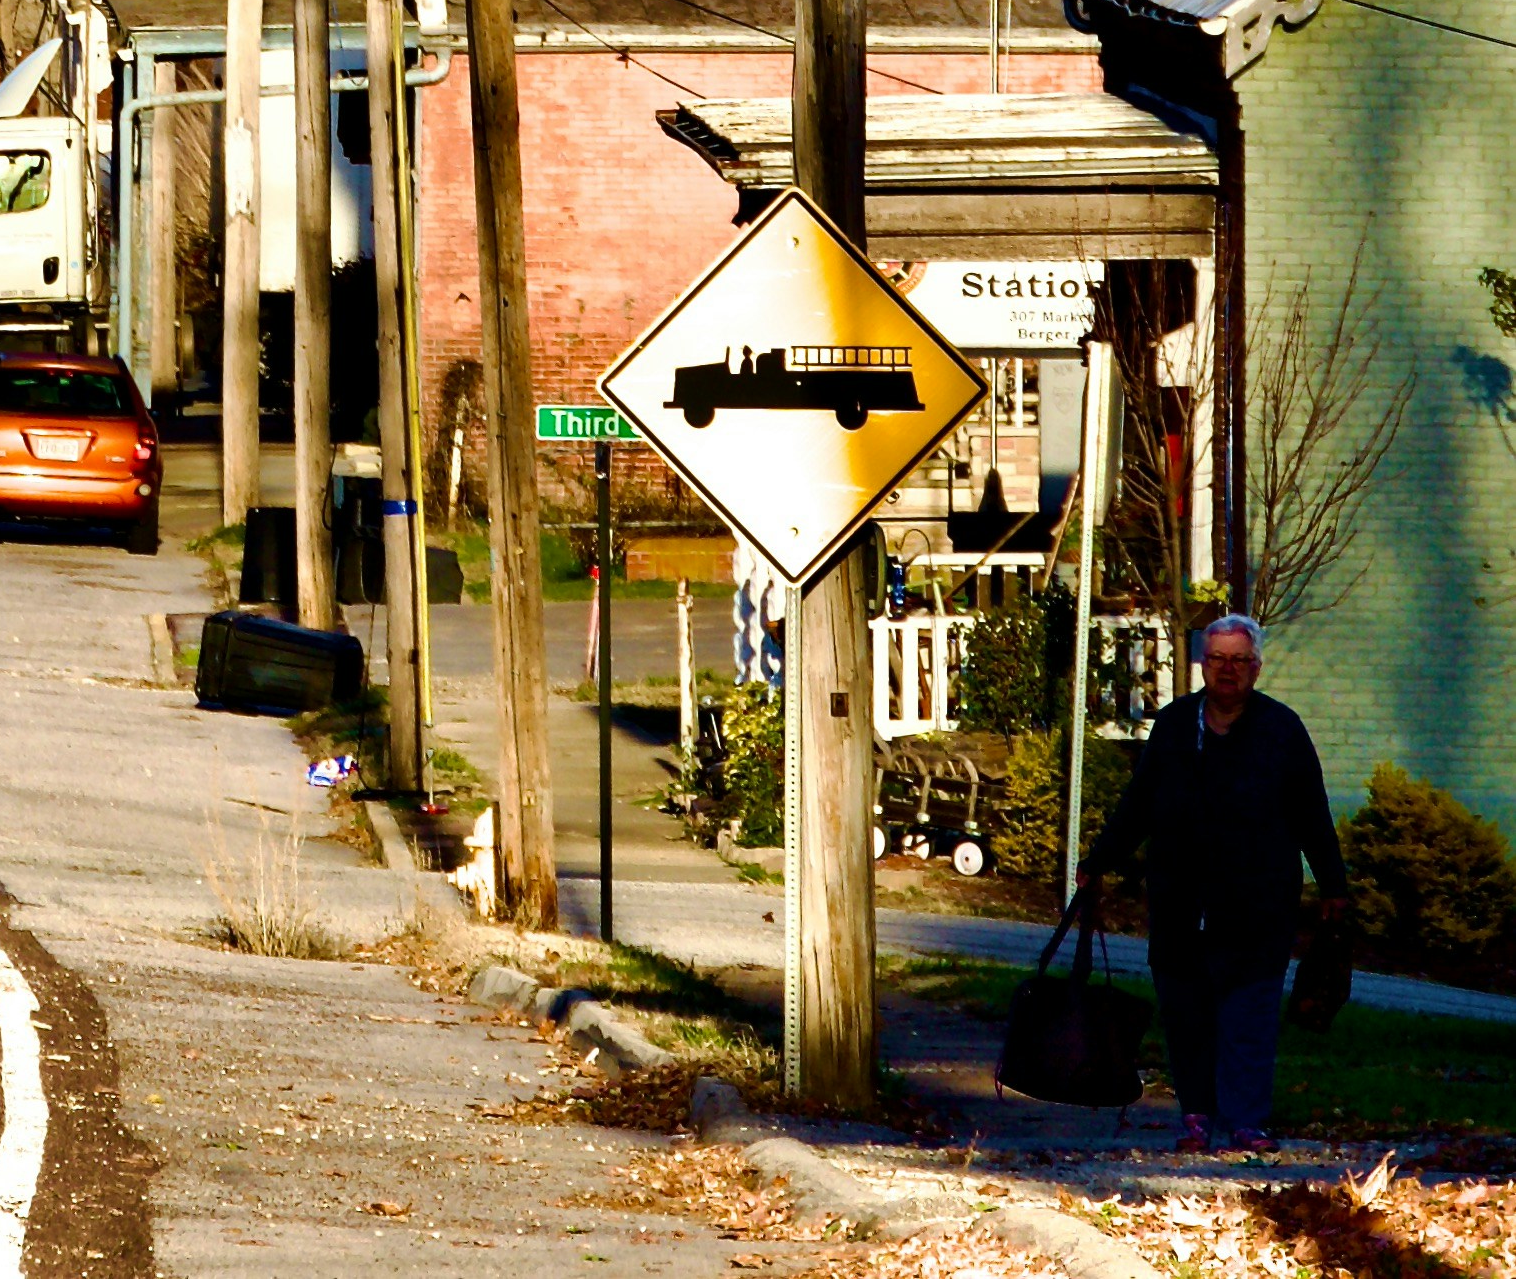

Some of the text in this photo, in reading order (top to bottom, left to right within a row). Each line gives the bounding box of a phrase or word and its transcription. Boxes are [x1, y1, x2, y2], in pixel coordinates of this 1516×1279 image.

[961, 271, 1104, 298] Station
[1010, 311, 1036, 322] 307
[550, 410, 620, 435] Third
